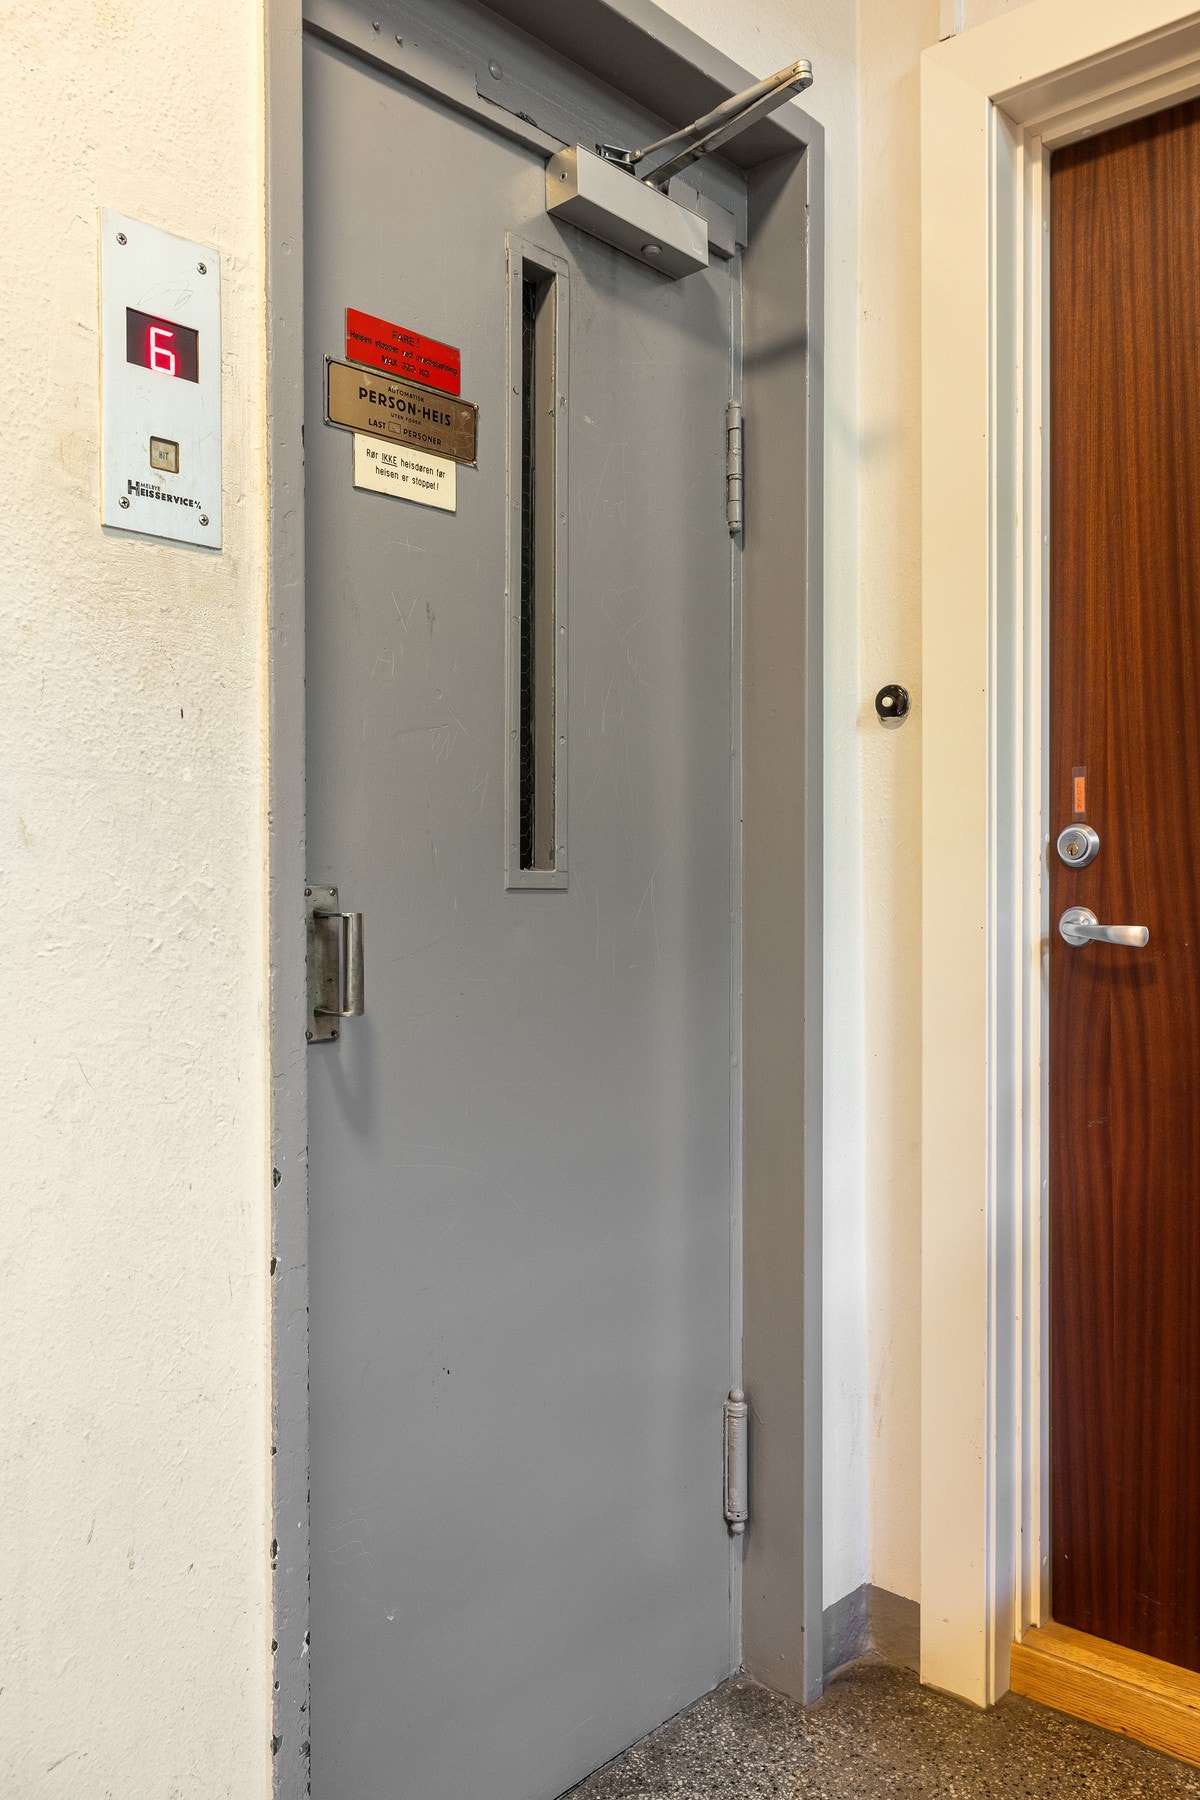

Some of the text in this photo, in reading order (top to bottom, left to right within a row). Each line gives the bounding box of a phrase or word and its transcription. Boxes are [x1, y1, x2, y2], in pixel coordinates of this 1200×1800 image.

[149, 326, 176, 377] 6
[381, 354, 398, 368] MAX
[419, 368, 430, 378] KG
[358, 386, 452, 427] PERSON-HEIS
[387, 386, 425, 403] AUTOMATISK
[391, 412, 404, 420] UTEN
[368, 418, 386, 430] LAST
[403, 428, 442, 446] PERSONER
[366, 448, 446, 479] Rør IKKE heisdøren før
[375, 465, 440, 491] heisen er stoppet!
[127, 479, 194, 508] HEISSERVICE
